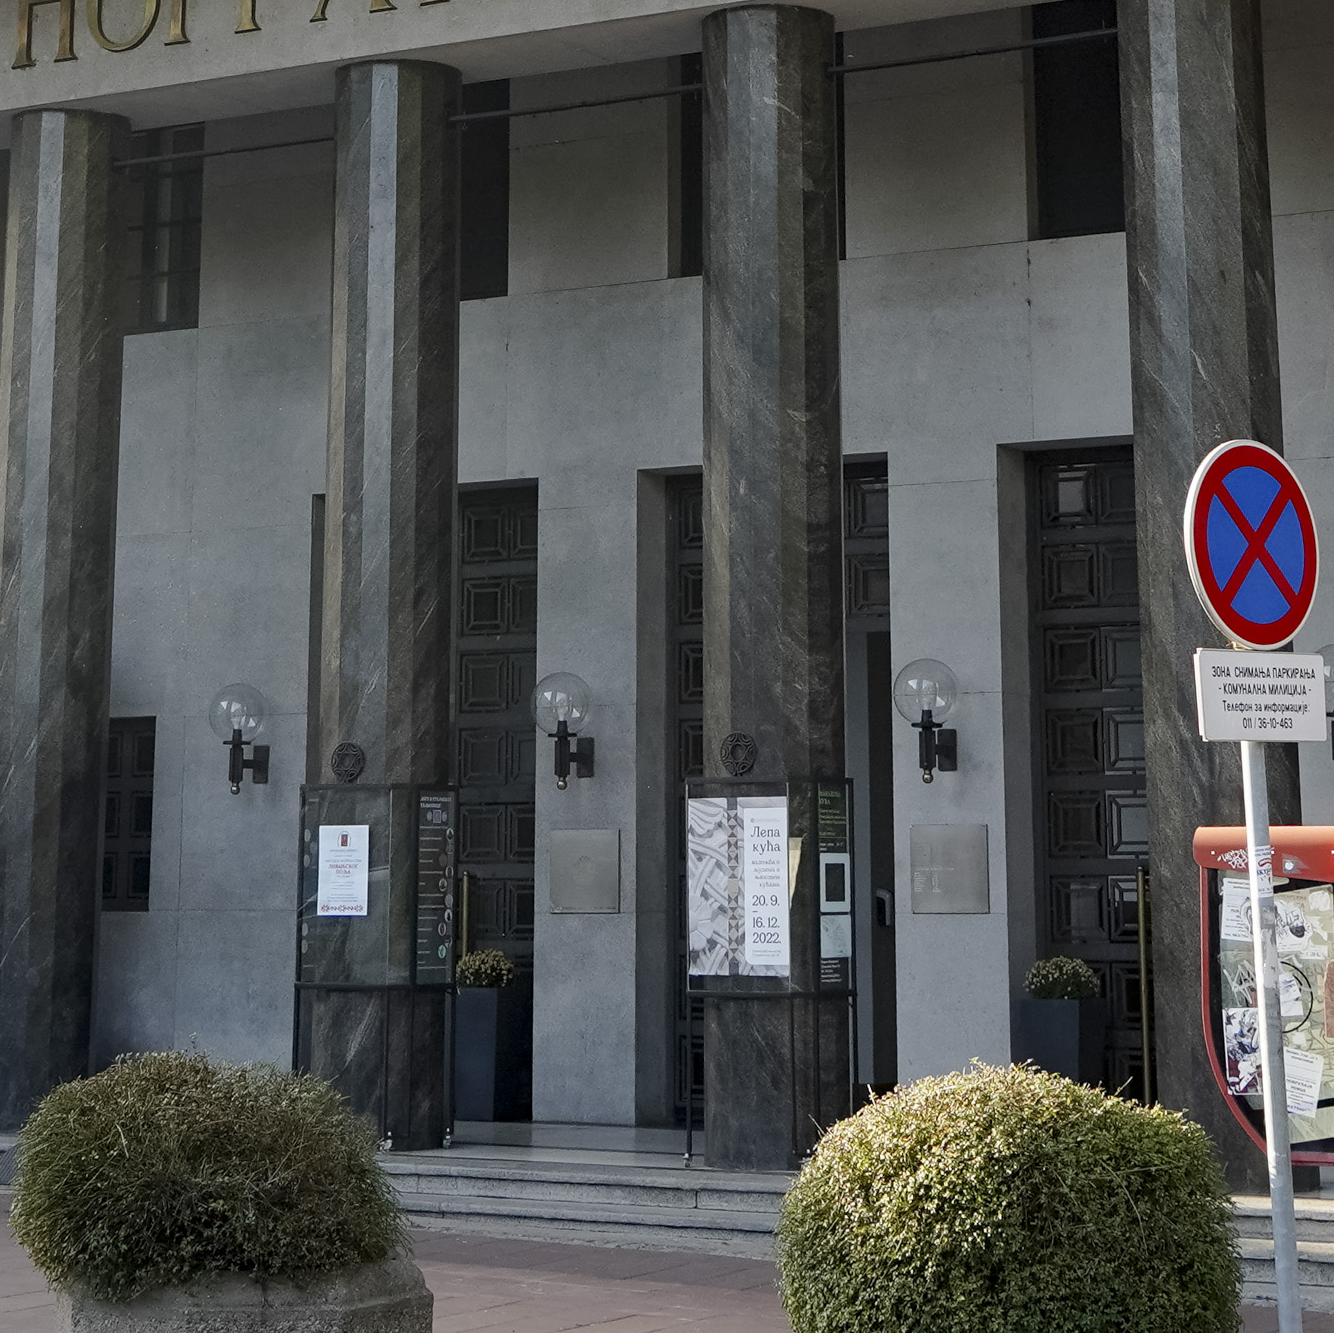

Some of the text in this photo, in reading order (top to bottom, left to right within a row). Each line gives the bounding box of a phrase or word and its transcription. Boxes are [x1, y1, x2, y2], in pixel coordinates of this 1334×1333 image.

[1212, 666, 1316, 679] ЗОНА СНИМАЊА ПАРКИРАЊА
[1223, 683, 1267, 695] КОМУНАЛНА
[1268, 684, 1307, 697] МИЛИЦИЈА
[1222, 700, 1252, 713] Телефон
[750, 826, 780, 837] Лепа
[752, 840, 781, 855] кућа
[752, 895, 780, 907] 20. 9.
[752, 917, 780, 928] 16. 12.
[752, 932, 781, 944] 2022.
